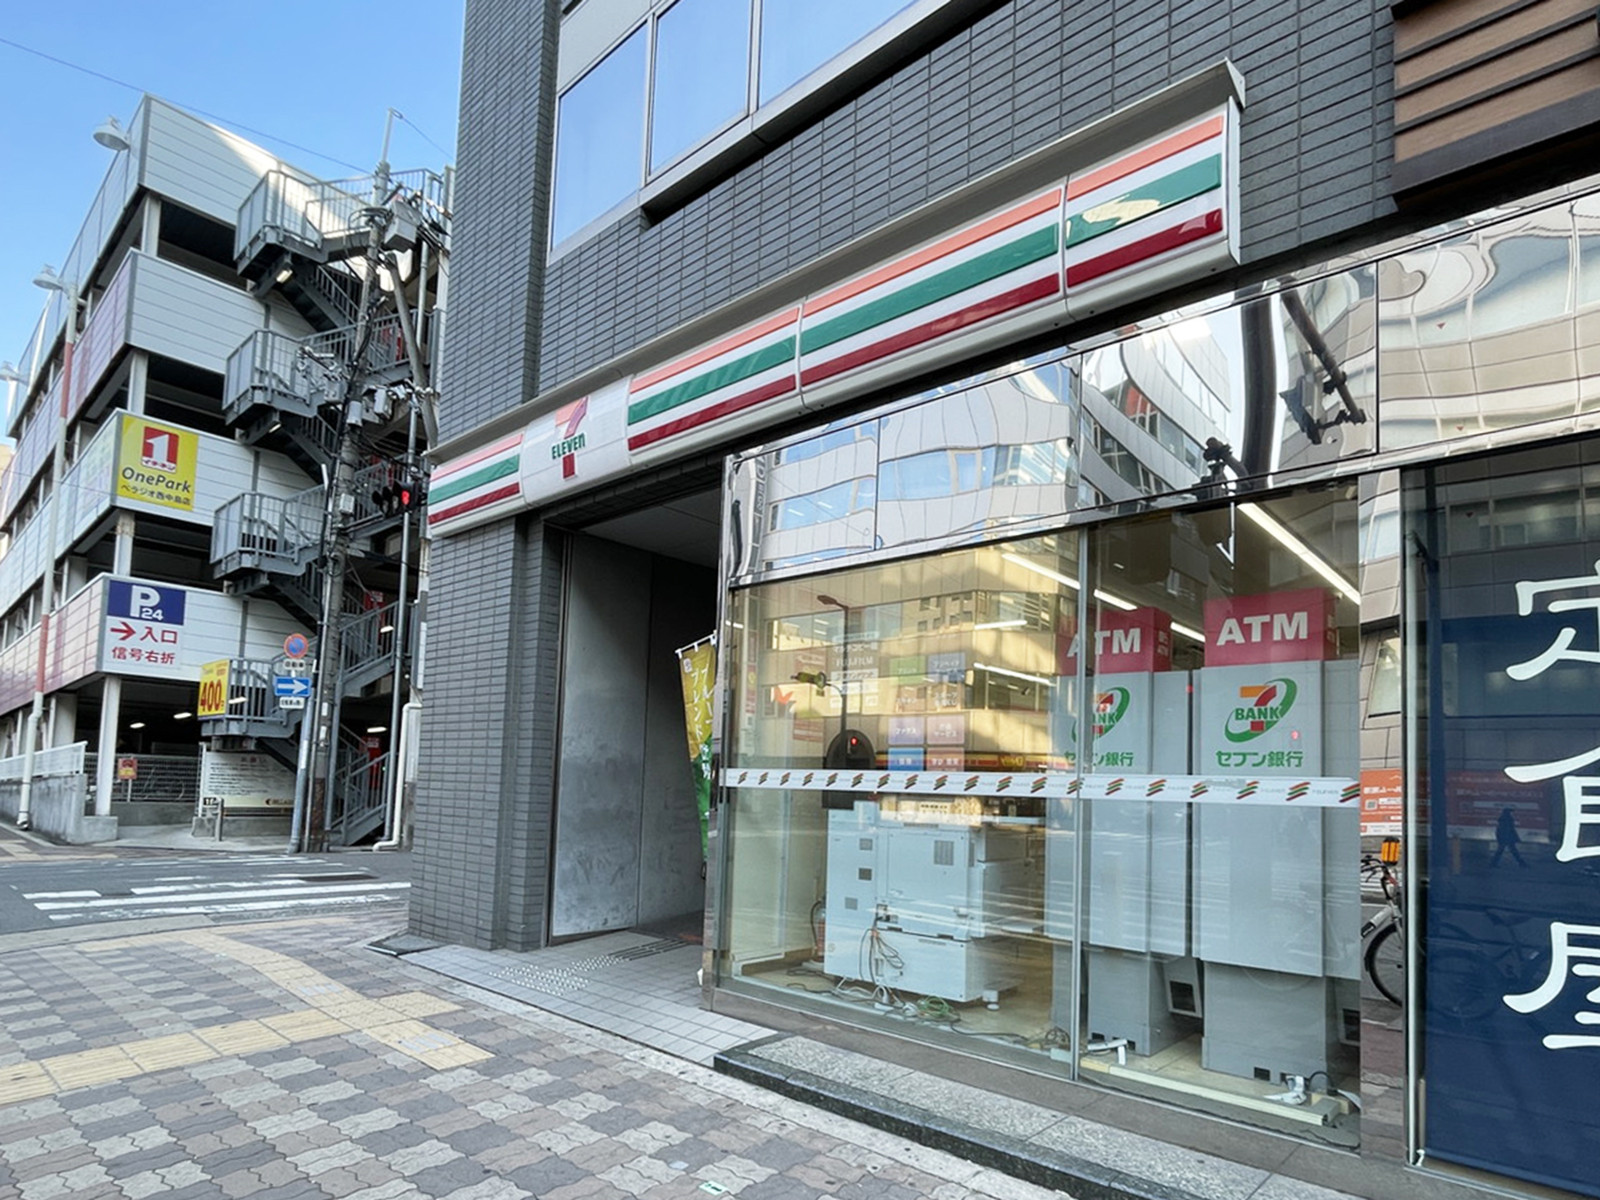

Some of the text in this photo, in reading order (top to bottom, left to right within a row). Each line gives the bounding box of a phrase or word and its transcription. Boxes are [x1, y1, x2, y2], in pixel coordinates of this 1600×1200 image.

[121, 466, 192, 494] OnePark
[139, 625, 178, 645] 入口
[1216, 612, 1308, 646] ATM
[112, 646, 176, 665] 信号右折
[1234, 706, 1281, 721] BANK
